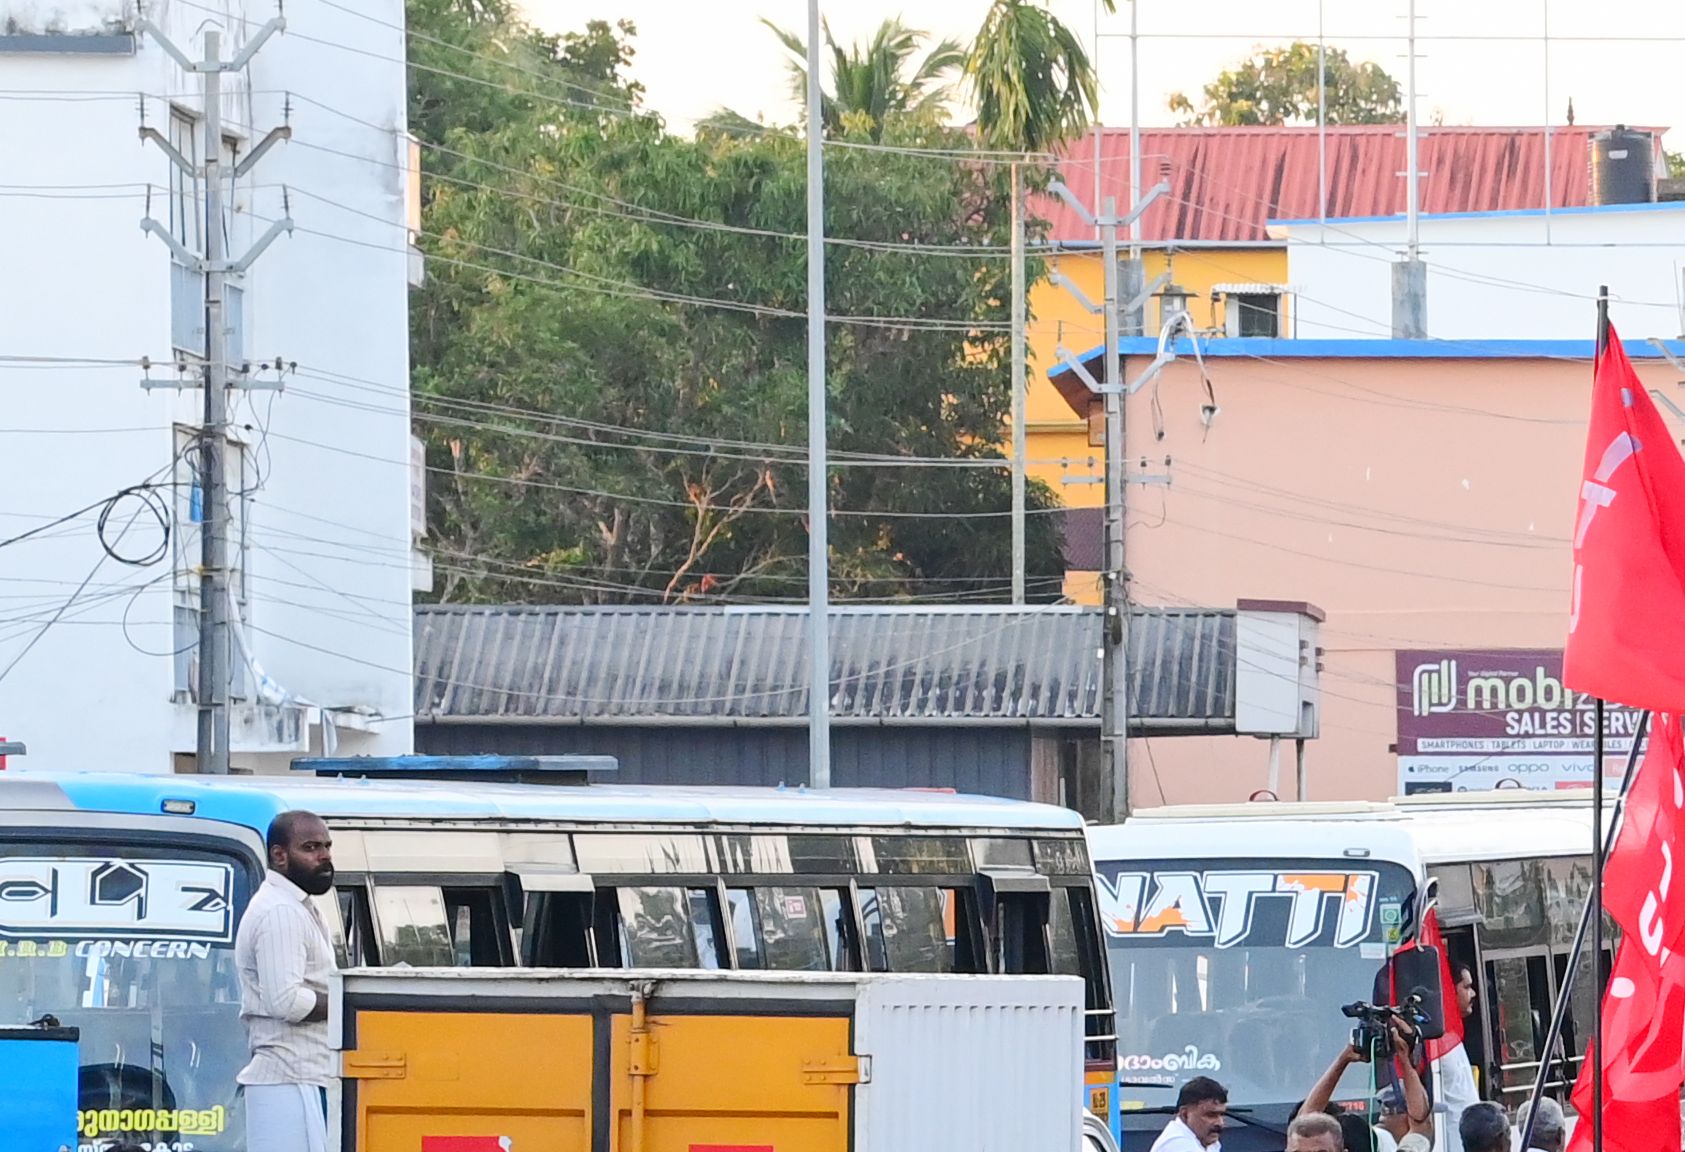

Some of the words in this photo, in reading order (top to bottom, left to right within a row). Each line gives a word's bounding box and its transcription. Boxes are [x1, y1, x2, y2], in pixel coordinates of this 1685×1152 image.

[1505, 711, 1573, 734] SALES
[1422, 740, 1484, 749] SMARTPHONES
[1417, 764, 1449, 773] iPhone
[75, 940, 211, 959] CONCERN
[77, 1105, 225, 1137] രുനാഗപ്പള്ളി
